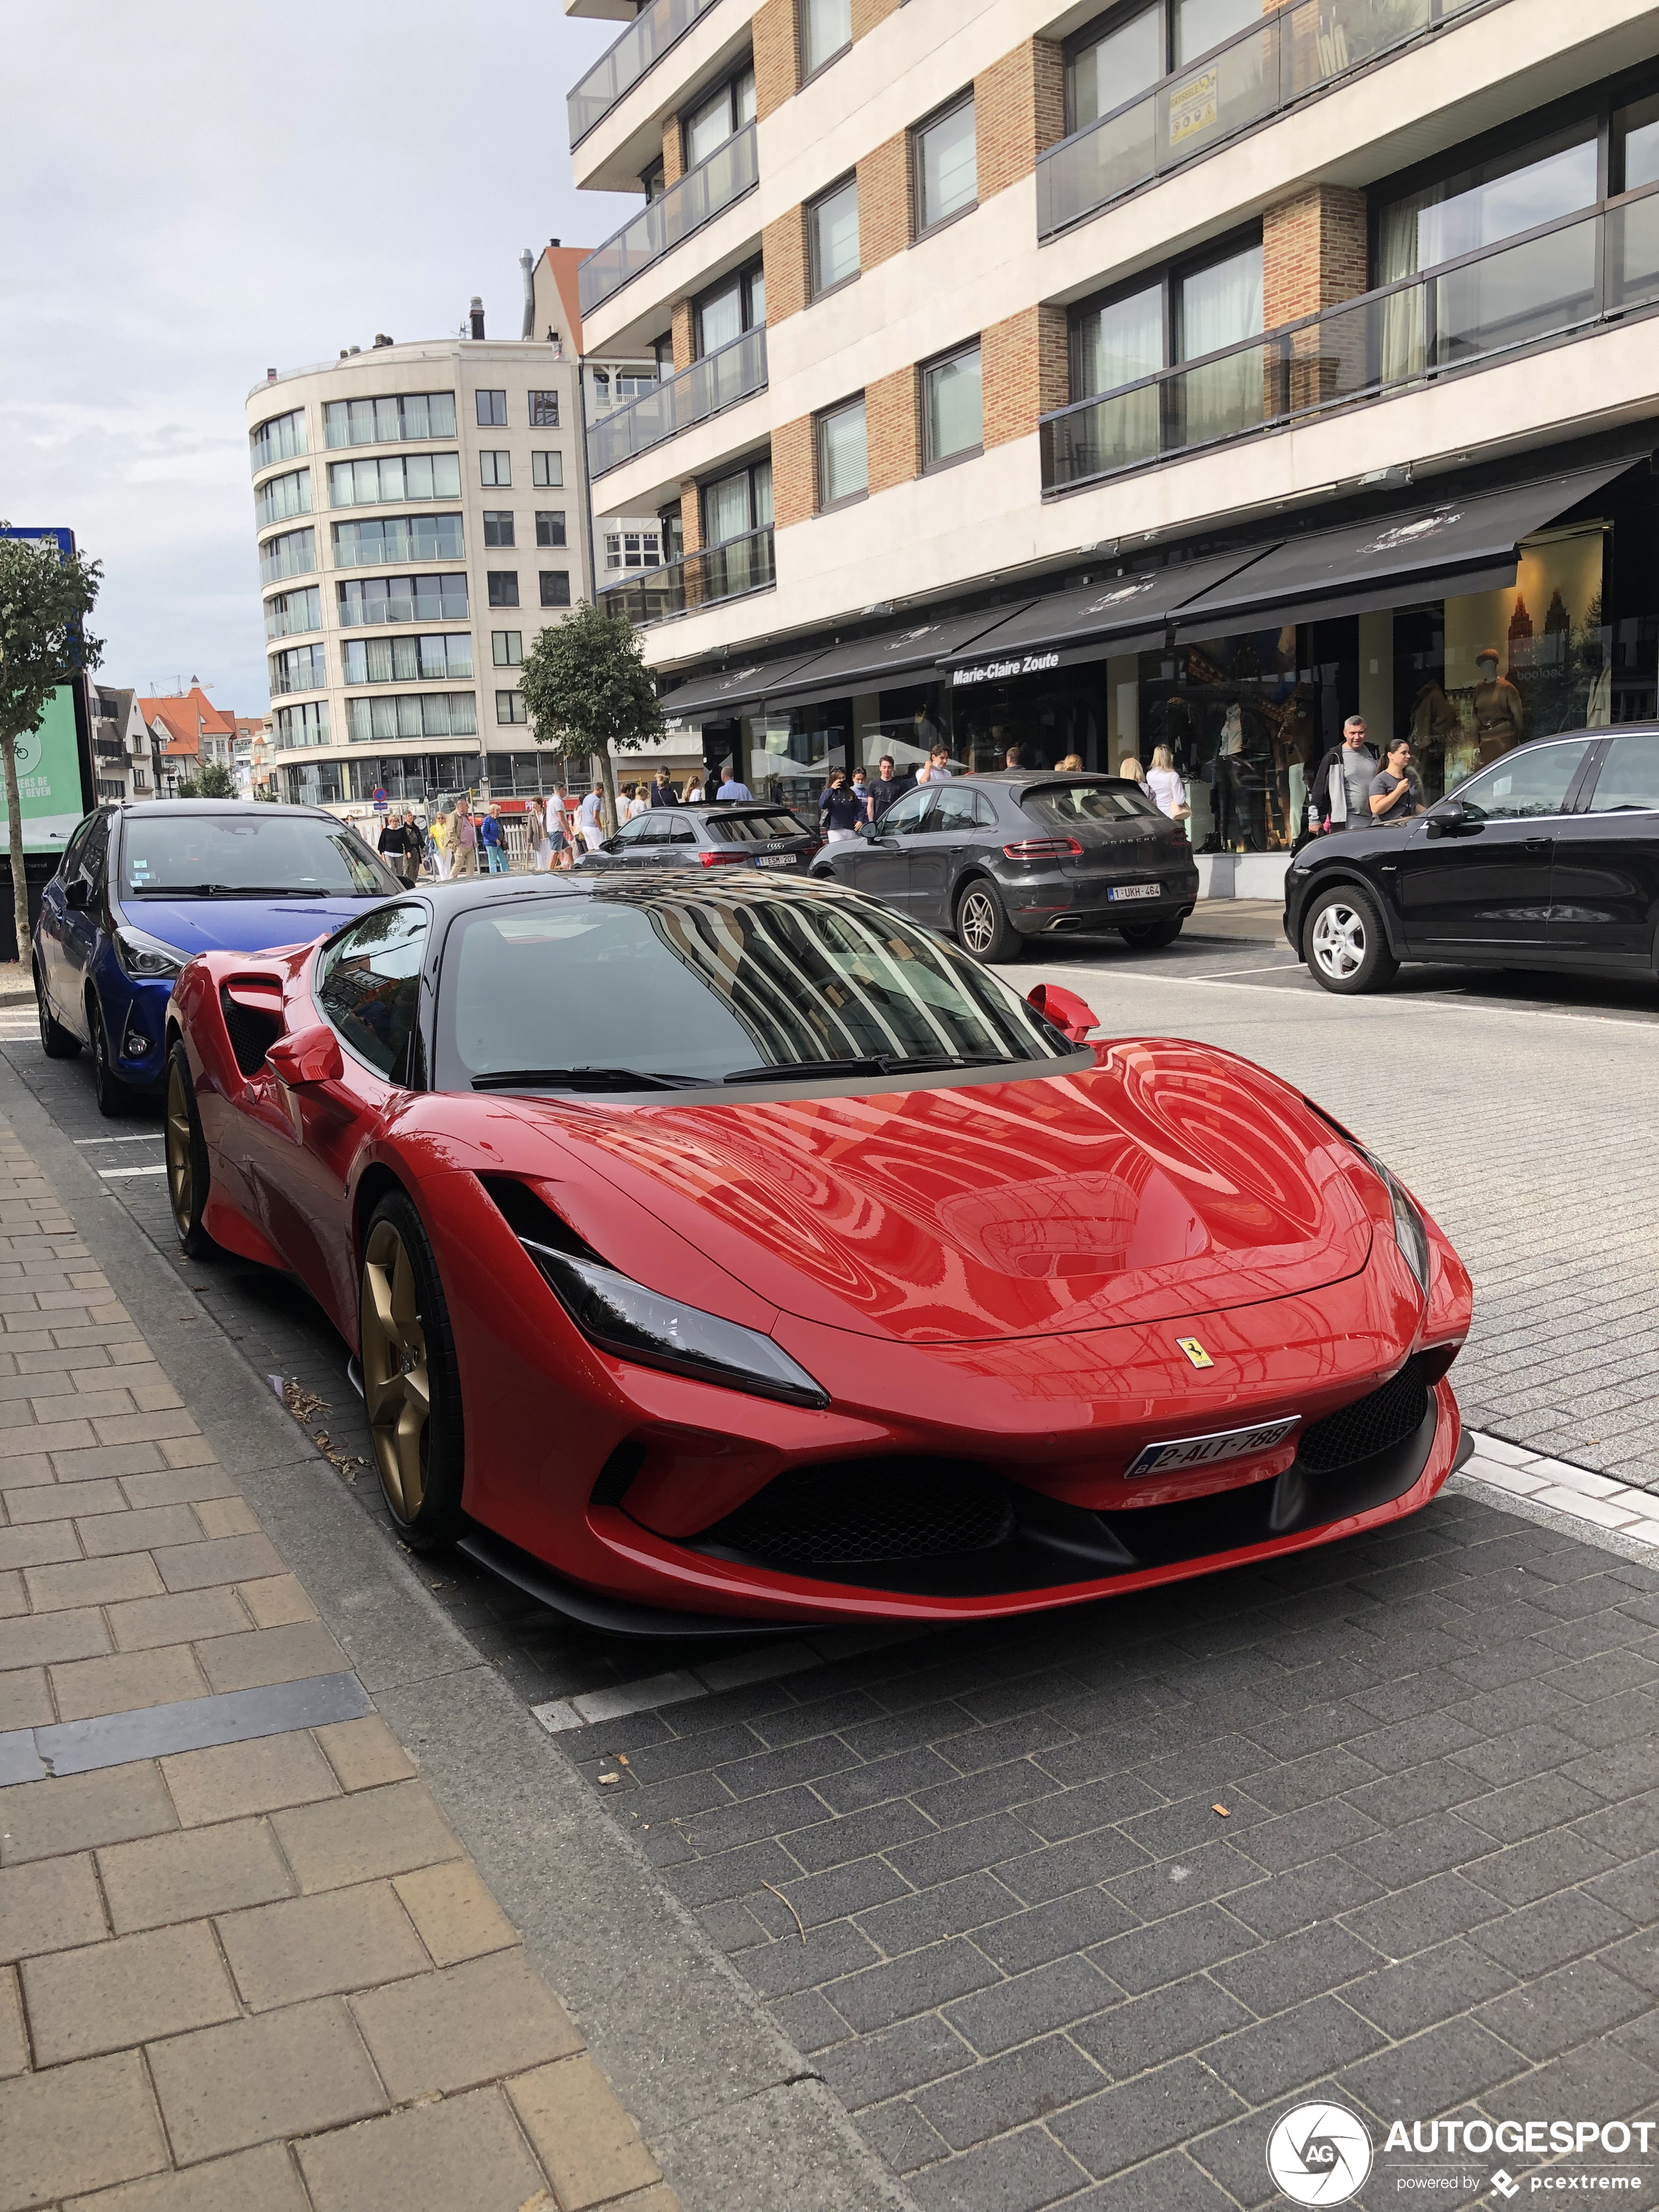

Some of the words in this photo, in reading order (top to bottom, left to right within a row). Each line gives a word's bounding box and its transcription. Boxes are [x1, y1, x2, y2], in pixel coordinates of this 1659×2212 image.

[952, 660, 1021, 686] Marie-Claire
[1022, 652, 1059, 673] Zoute
[664, 716, 683, 729] Zoute
[37, 776, 48, 787] DE
[25, 786, 52, 798] GEVEN
[1135, 1464, 1148, 1475] B
[1153, 1424, 1289, 1469] 2-ALT-788
